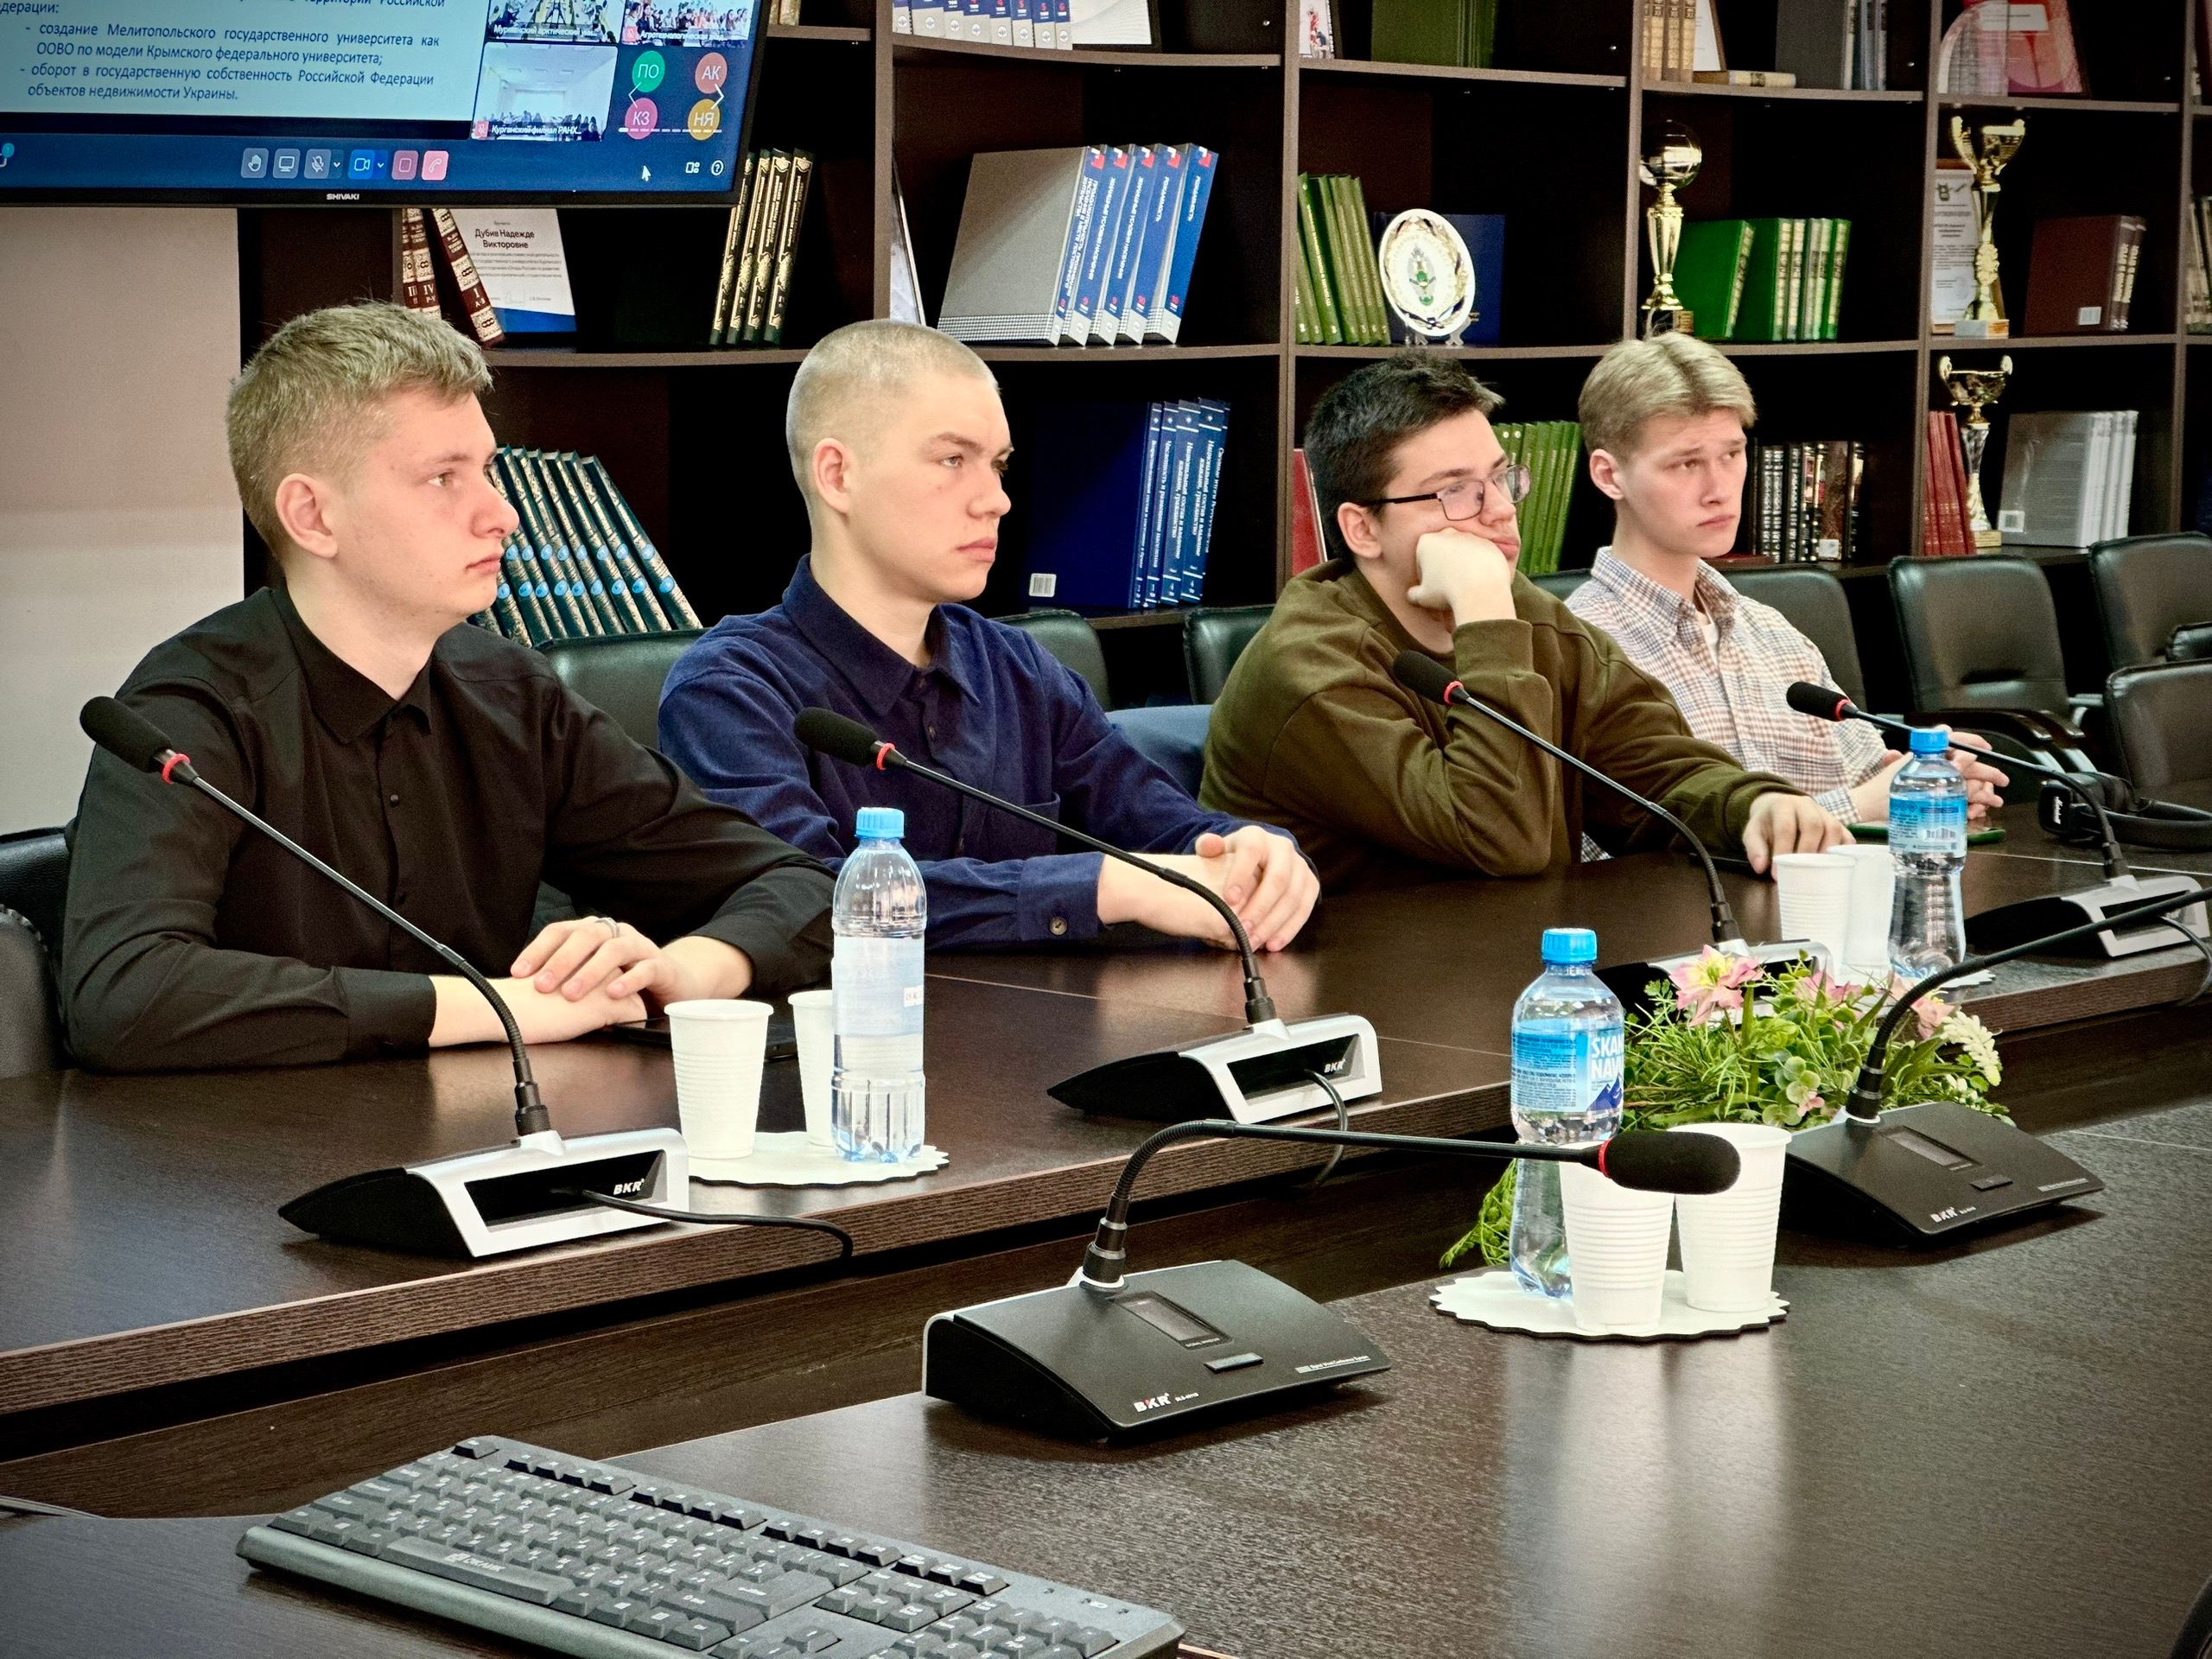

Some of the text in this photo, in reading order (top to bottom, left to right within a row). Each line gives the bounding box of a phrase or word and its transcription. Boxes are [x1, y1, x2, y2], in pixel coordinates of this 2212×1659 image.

[40, 23, 440, 47] создание Мелитопольского государственного университета как
[36, 42, 383, 66] ООВО по модели Крымского федерального университета;
[31, 63, 434, 86] оборот в государственную собственность Российской Федерации
[639, 65, 659, 79] ПО
[702, 66, 721, 80] АК
[28, 84, 238, 101] объектов недвижимости Украины.
[694, 112, 715, 126] НЯ
[474, 229, 535, 238] Дубив Надежде
[483, 240, 529, 250] Викторовне
[1324, 1060, 1344, 1074] BKR
[613, 1180, 643, 1196] BKR
[1134, 1395, 1172, 1413] BKR
